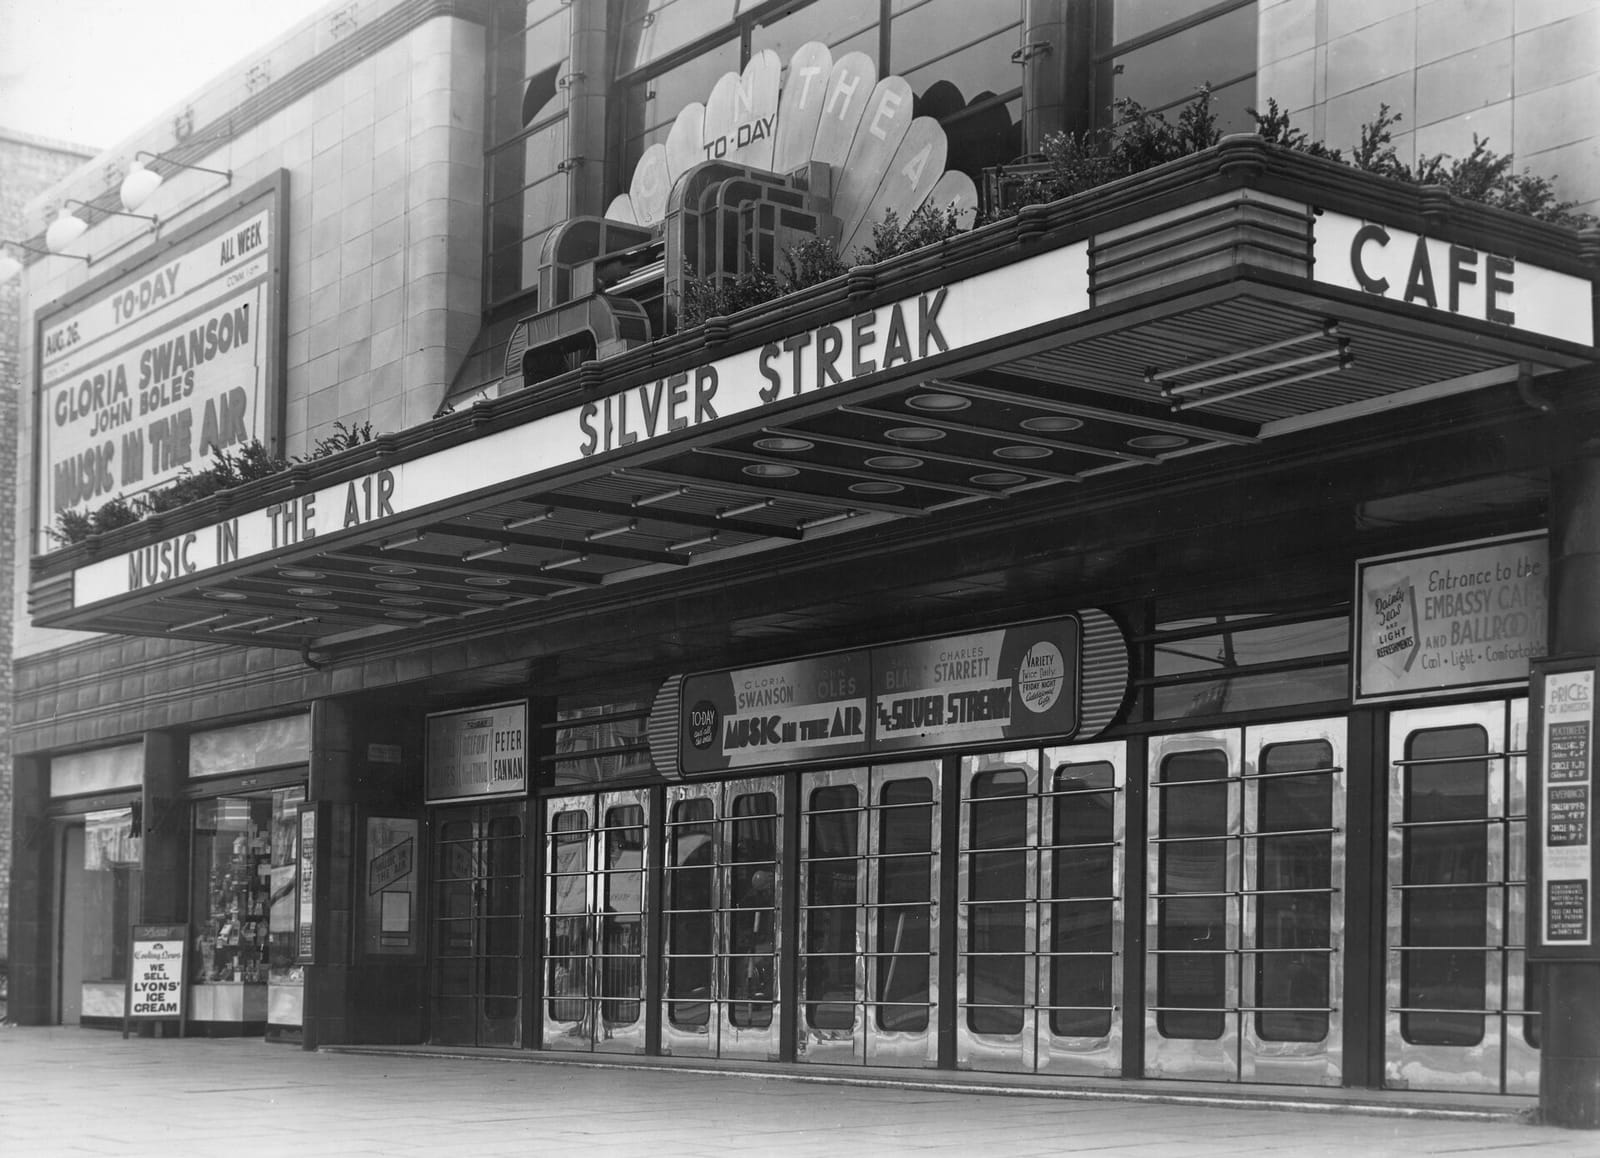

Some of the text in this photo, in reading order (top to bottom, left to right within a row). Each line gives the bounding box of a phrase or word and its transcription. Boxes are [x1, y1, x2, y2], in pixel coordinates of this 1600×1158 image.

[220, 236, 235, 266] ALL
[237, 220, 262, 256] WEEK
[1350, 224, 1515, 326] CAFE
[54, 303, 249, 427] GLORIA SWANSON
[579, 285, 950, 457] SILVER STREAK
[90, 371, 195, 438] JOHN BOLES
[54, 386, 248, 512] MUSIC IN THE AIR
[128, 533, 197, 592] MUSIC
[216, 518, 239, 565] IN
[267, 493, 316, 549] THE
[1428, 555, 1541, 593] Entrance to the
[1375, 587, 1405, 615] Dainty
[1424, 587, 1493, 621] EMBASSY
[1379, 626, 1406, 645] LIGHT
[1425, 634, 1447, 649] AND
[940, 646, 984, 662] CHARLES
[1421, 654, 1441, 670] Cool
[1451, 648, 1477, 671] Light
[934, 657, 990, 682] STARRETT
[738, 676, 857, 709] SWANSON OLES
[744, 676, 785, 690] GLORIA
[1022, 679, 1056, 693] FRIDAY NIGHT
[1551, 683, 1589, 703] PRICES
[892, 694, 944, 729] SILVER
[724, 715, 782, 749] MUSIC
[782, 721, 797, 743] IN
[799, 718, 830, 742] THE
[830, 706, 864, 737] AIR
[495, 729, 522, 753] PETER
[143, 972, 170, 981] SELL
[149, 963, 165, 972] WE
[134, 981, 180, 992] LYONS'
[145, 992, 165, 1002] ICE
[134, 1002, 177, 1013] CREAM
